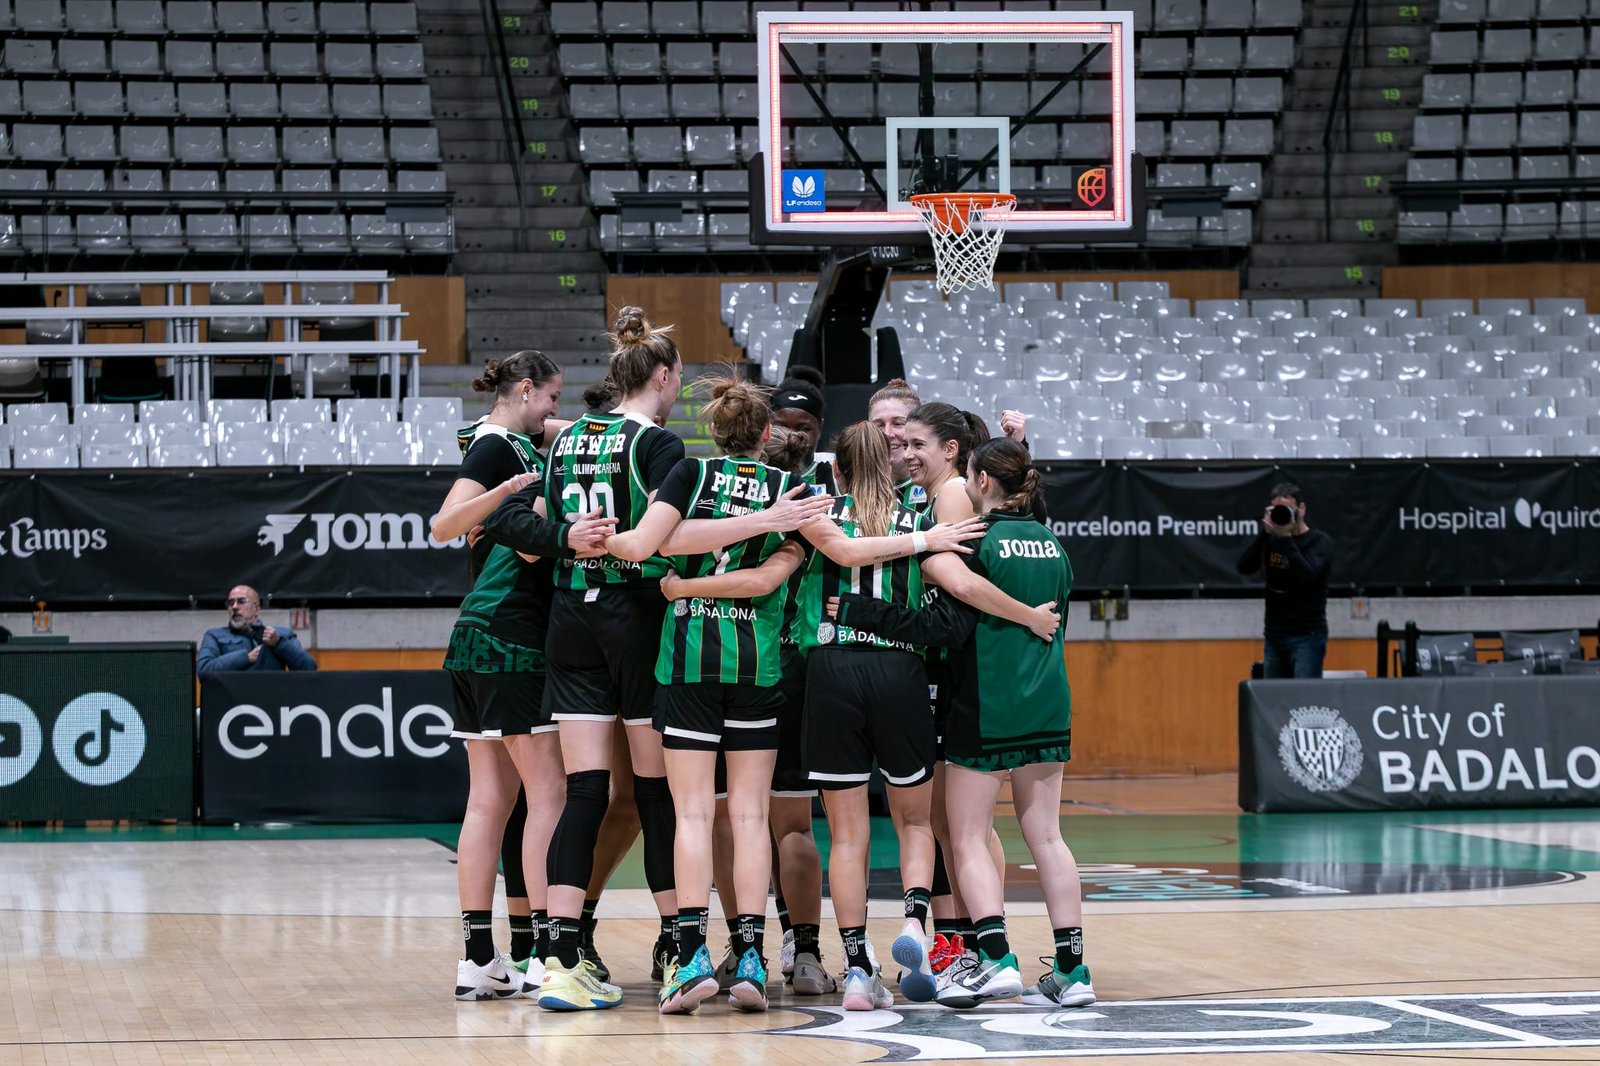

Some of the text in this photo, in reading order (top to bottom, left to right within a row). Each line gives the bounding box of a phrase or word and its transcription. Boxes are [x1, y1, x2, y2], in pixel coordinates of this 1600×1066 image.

[1400, 6, 1418, 16] 21
[503, 17, 521, 27] 21
[511, 57, 529, 68] 20
[523, 99, 538, 110] 19
[1375, 132, 1393, 143] 18
[530, 143, 546, 153] 18
[1365, 177, 1381, 187] 17
[541, 186, 557, 197] 17
[550, 230, 566, 241] 16
[559, 275, 577, 287] 15
[555, 433, 626, 457] BREWER
[711, 471, 770, 502] PIERA
[1157, 515, 1259, 536] Premium
[1399, 506, 1506, 535] Hospital
[999, 539, 1060, 558] Joma
[1372, 703, 1506, 746] City of
